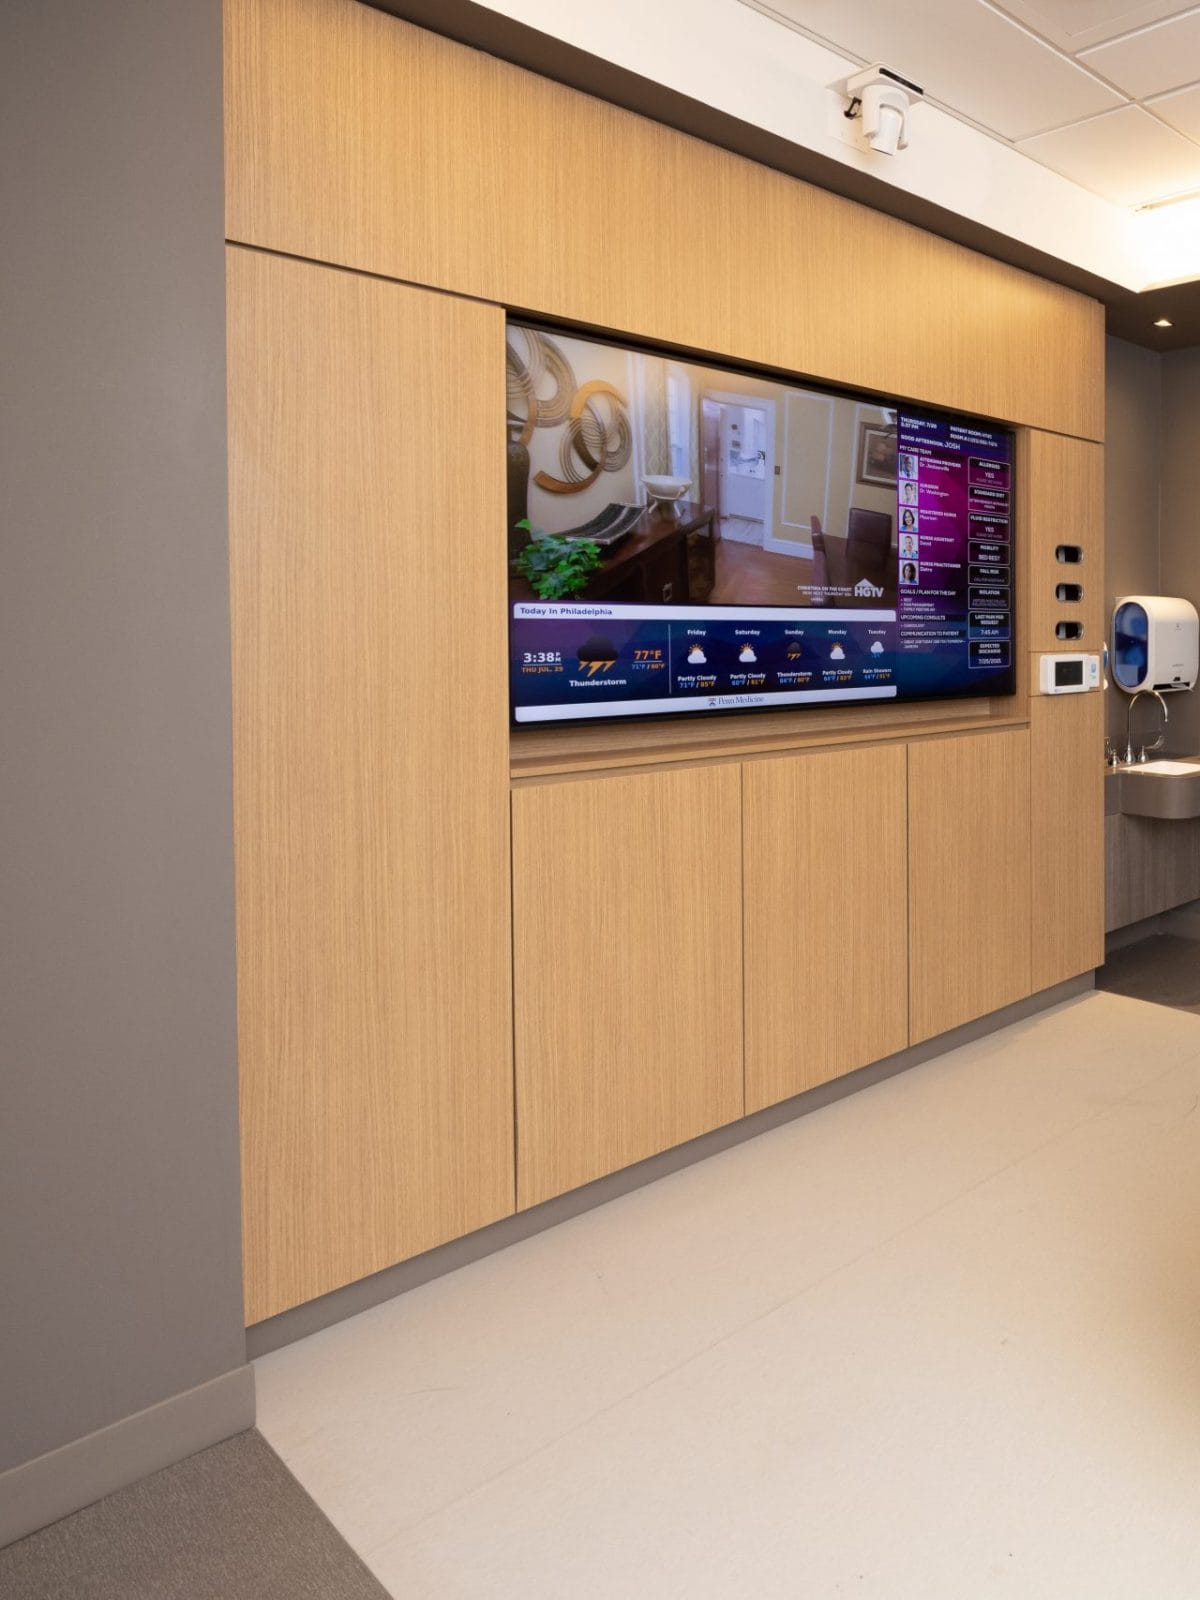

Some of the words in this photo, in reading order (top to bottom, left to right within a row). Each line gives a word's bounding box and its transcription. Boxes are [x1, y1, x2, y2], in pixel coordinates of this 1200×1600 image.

[944, 442, 960, 450] JOSH
[854, 586, 884, 598] HGTV
[520, 608, 547, 616] Today
[560, 608, 613, 617] Philadelphia
[523, 652, 554, 663] 3:38
[634, 650, 662, 660] 77°F
[568, 678, 627, 688] Thunderstorm
